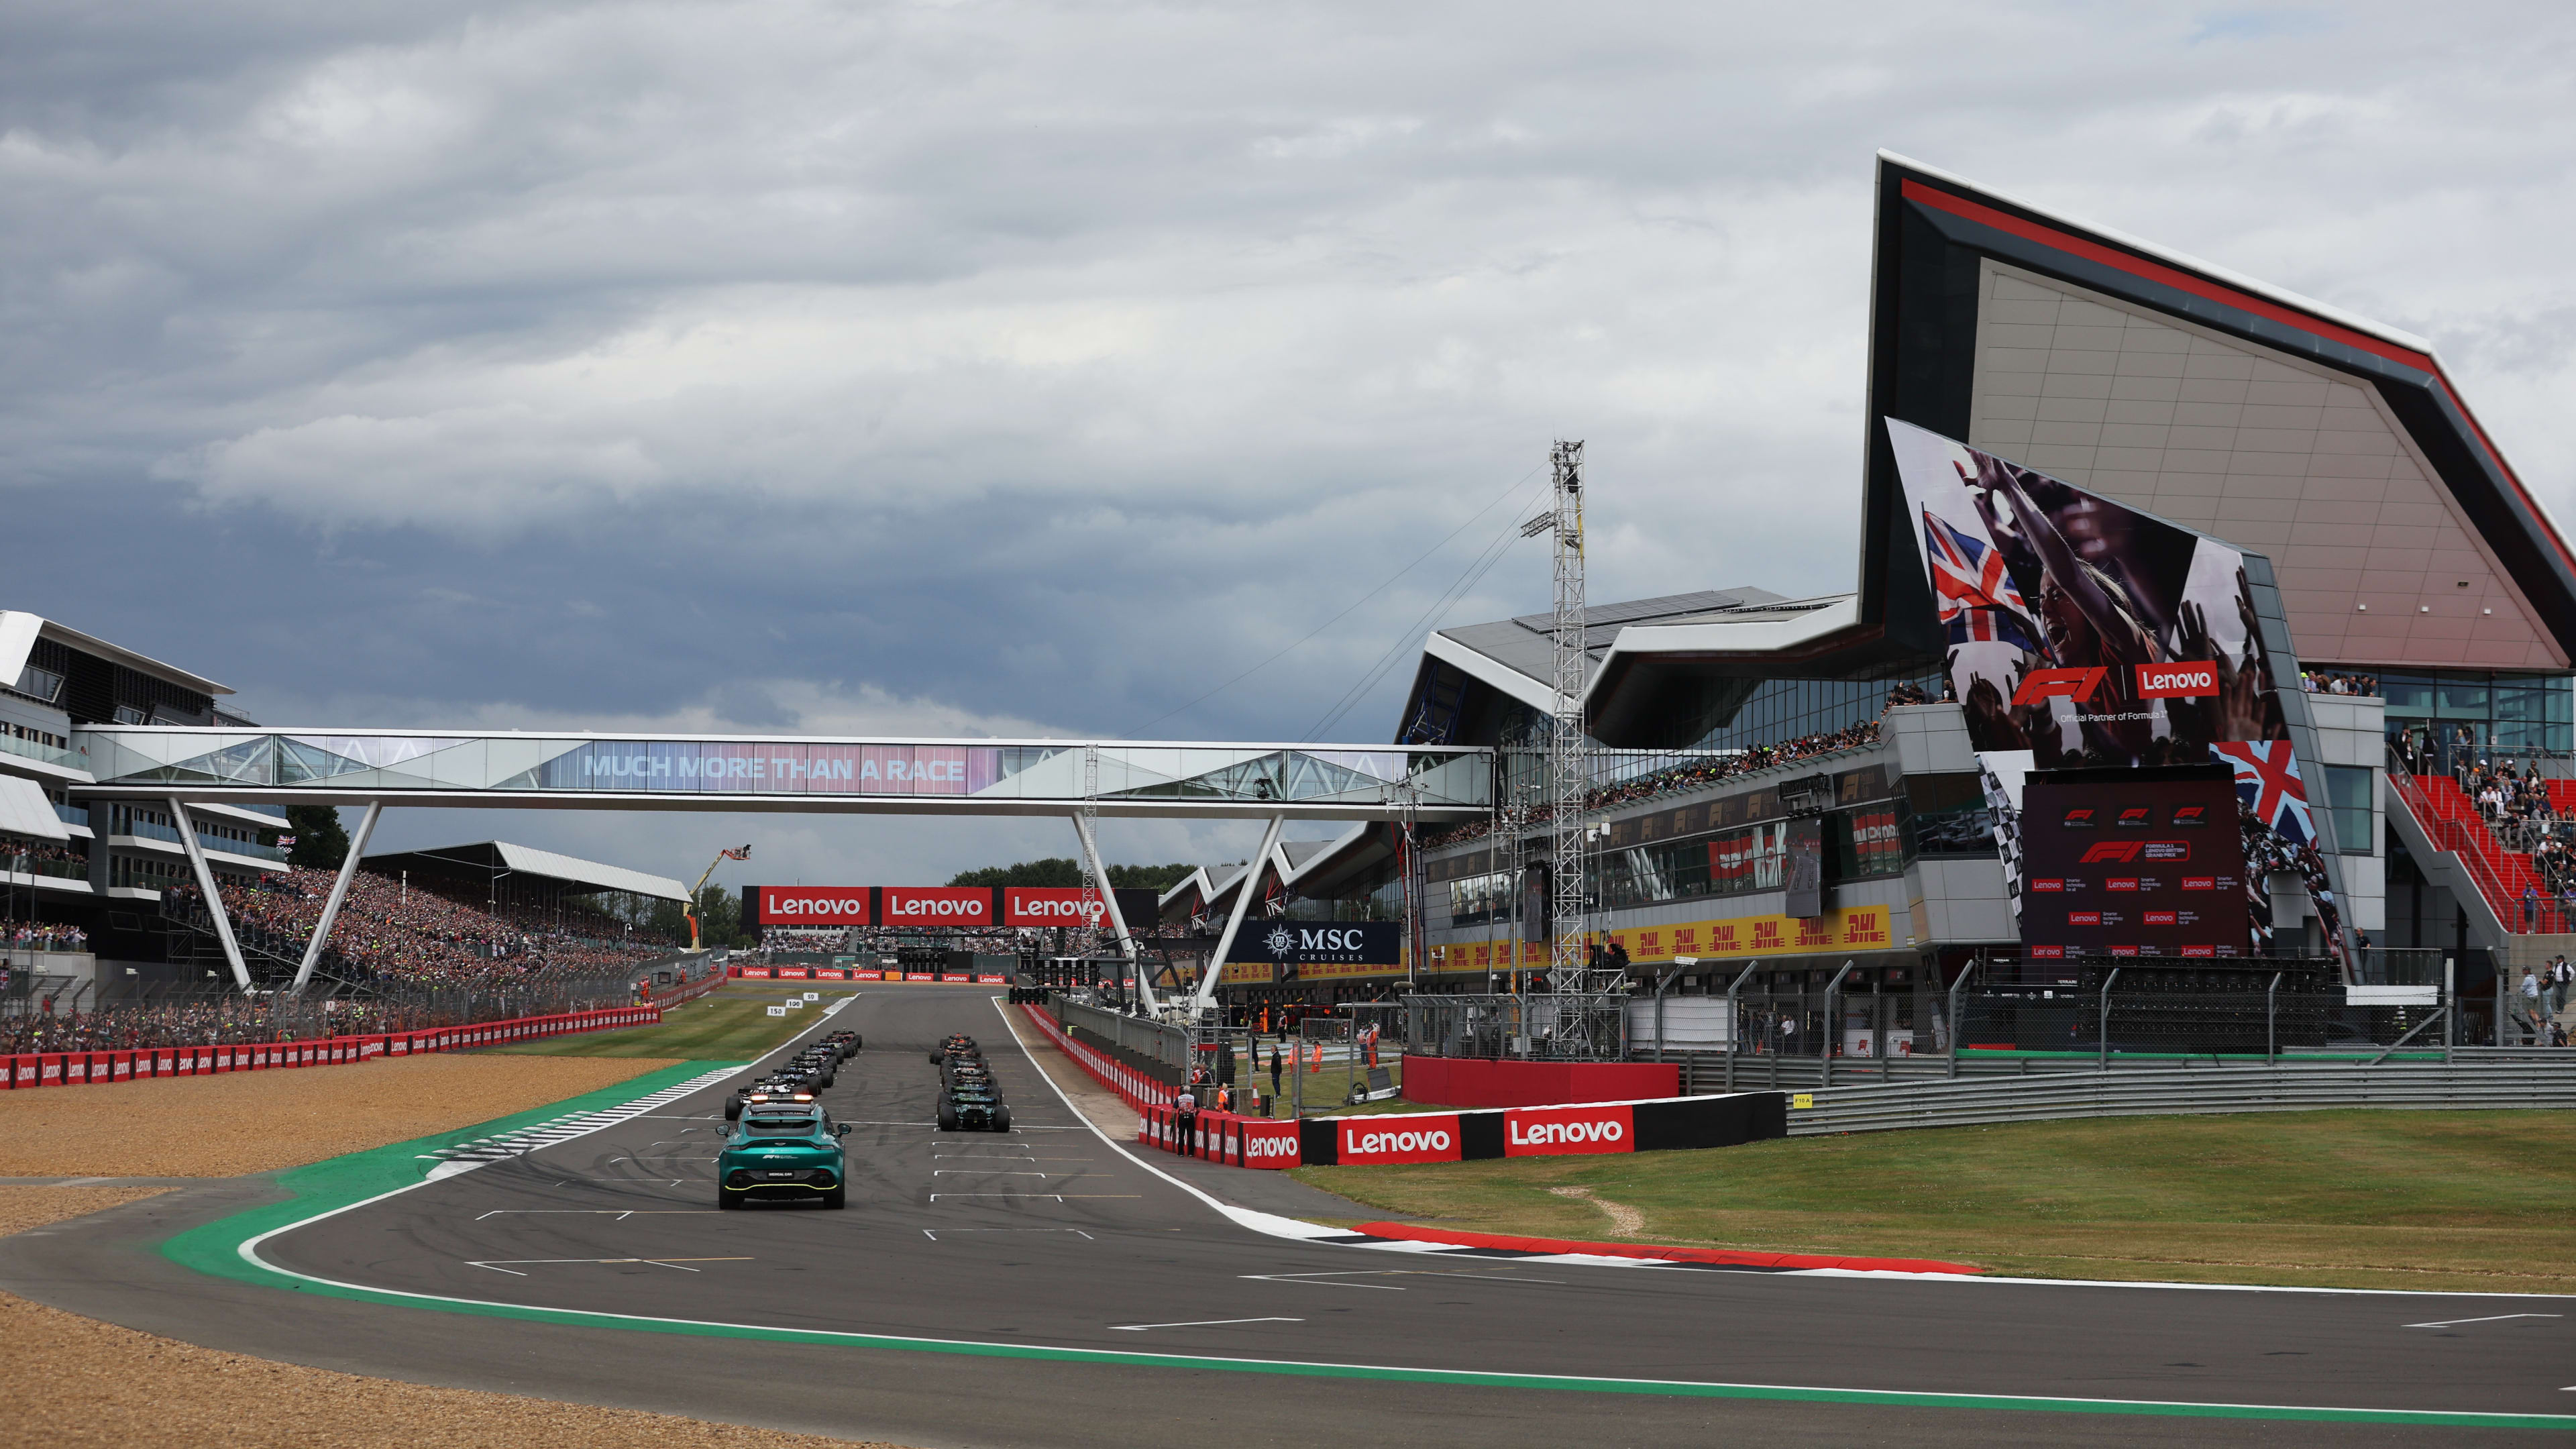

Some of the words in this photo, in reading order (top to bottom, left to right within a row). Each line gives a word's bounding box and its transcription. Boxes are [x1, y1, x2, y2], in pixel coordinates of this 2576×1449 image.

[2143, 672, 2211, 690] Lenovo
[2061, 714, 2087, 723] Official
[2088, 713, 2116, 722] Partner
[2118, 712, 2127, 720] of
[2128, 712, 2159, 720] Formula
[584, 755, 671, 777] MUCH
[679, 757, 765, 778] MORE
[771, 758, 852, 780] THAN
[859, 759, 880, 780] A
[887, 760, 965, 782] RACE
[769, 894, 860, 915] Lenovo
[892, 896, 983, 916] Lenovo
[1014, 896, 1106, 916] Lenovo
[1712, 925, 1738, 951] DHL
[1753, 921, 1782, 949] DHL
[1798, 918, 1829, 947] DHL
[1847, 913, 1882, 943] DHL
[1299, 929, 1362, 950] MSC
[1640, 932, 1661, 956] DHL
[1674, 928, 1699, 954] DHL
[270, 1051, 282, 1063] Lenovo
[287, 1050, 297, 1062] Lenovo
[370, 1042, 383, 1052] enovo
[115, 1060, 129, 1075] Lenovo
[136, 1057, 150, 1072] Lenovo
[218, 1053, 230, 1067] Lenovo
[236, 1051, 248, 1065] Lenovo
[254, 1051, 266, 1065] Lenovo
[17, 1064, 35, 1080] Lenovo
[43, 1062, 60, 1079] Lenovo
[69, 1061, 85, 1077] Lenovo
[92, 1062, 108, 1077] Lenovo
[1209, 1128, 1220, 1151] Lenovo
[1346, 1129, 1450, 1153] Lenovo
[1511, 1120, 1623, 1145] Lenovo
[1226, 1130, 1238, 1156] Lenovo
[1246, 1133, 1297, 1157] Lenovo
